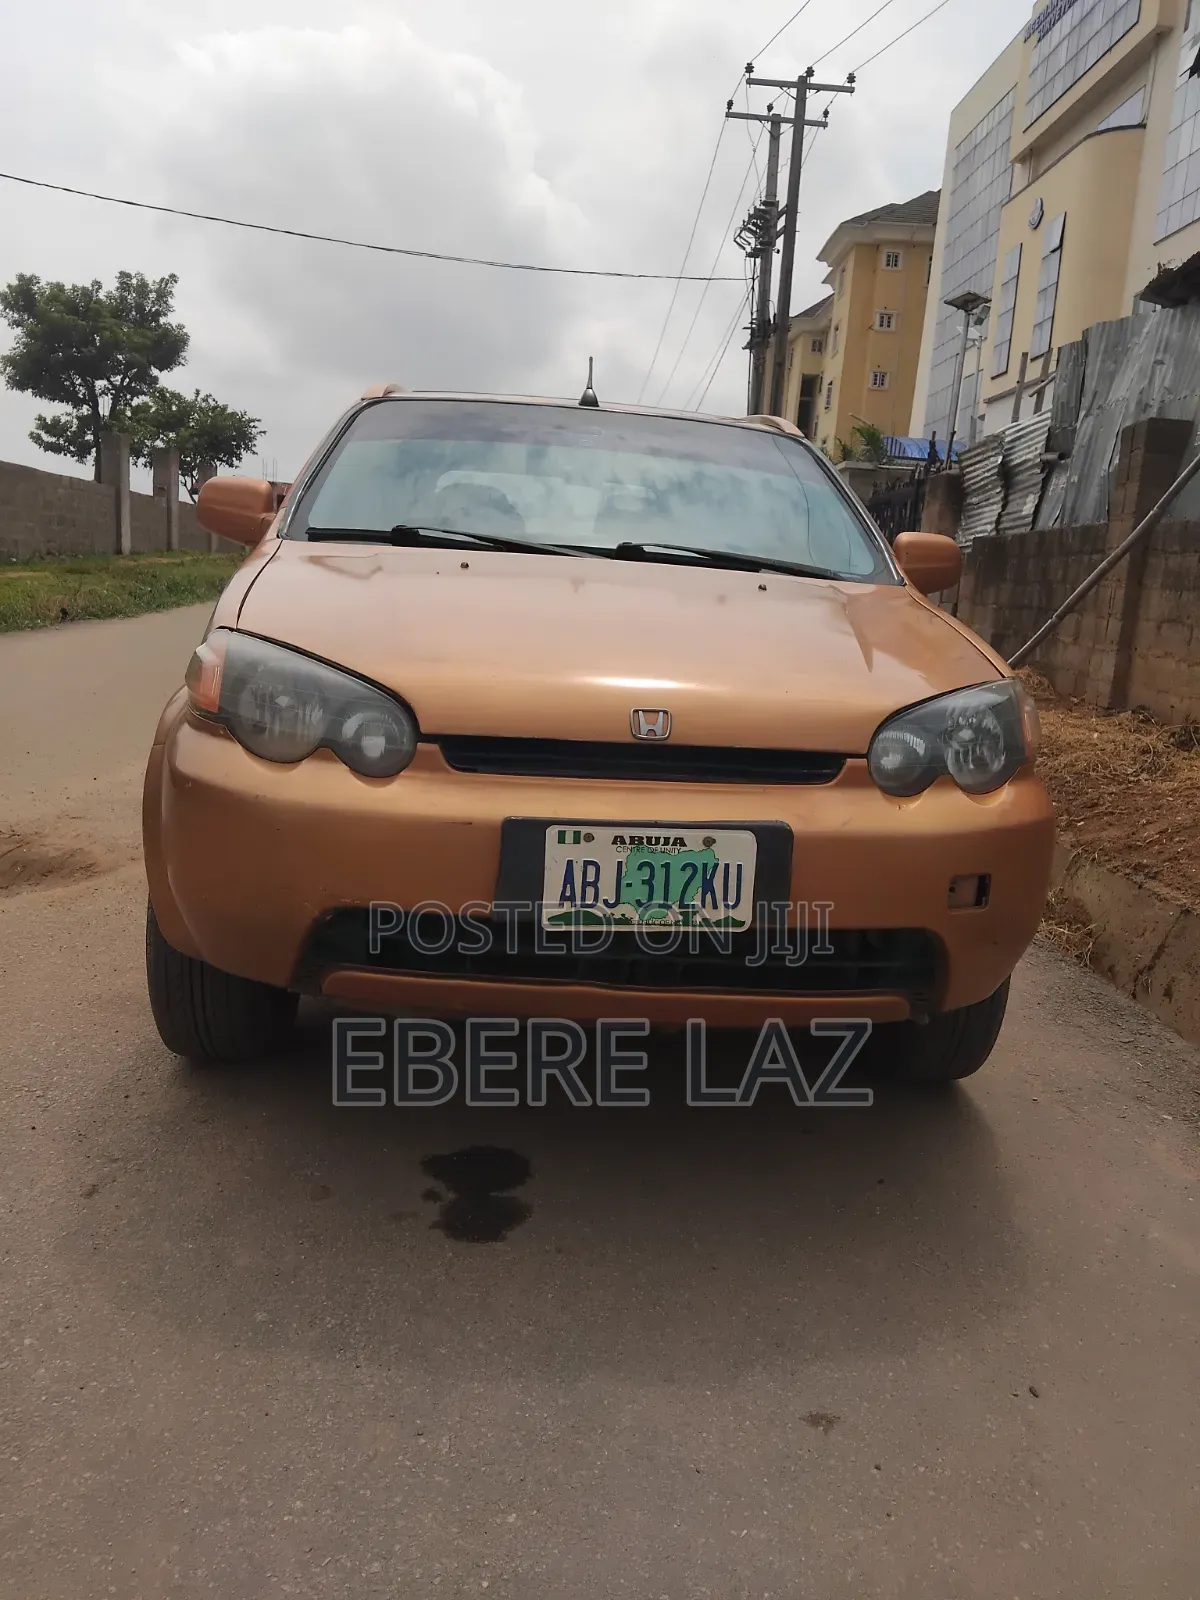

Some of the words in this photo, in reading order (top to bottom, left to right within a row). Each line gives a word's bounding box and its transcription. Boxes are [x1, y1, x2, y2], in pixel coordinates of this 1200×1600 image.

[611, 835, 687, 847] ABUJA
[616, 845, 646, 854] CENTRE
[648, 846, 658, 854] OF
[660, 846, 681, 854] UNITY
